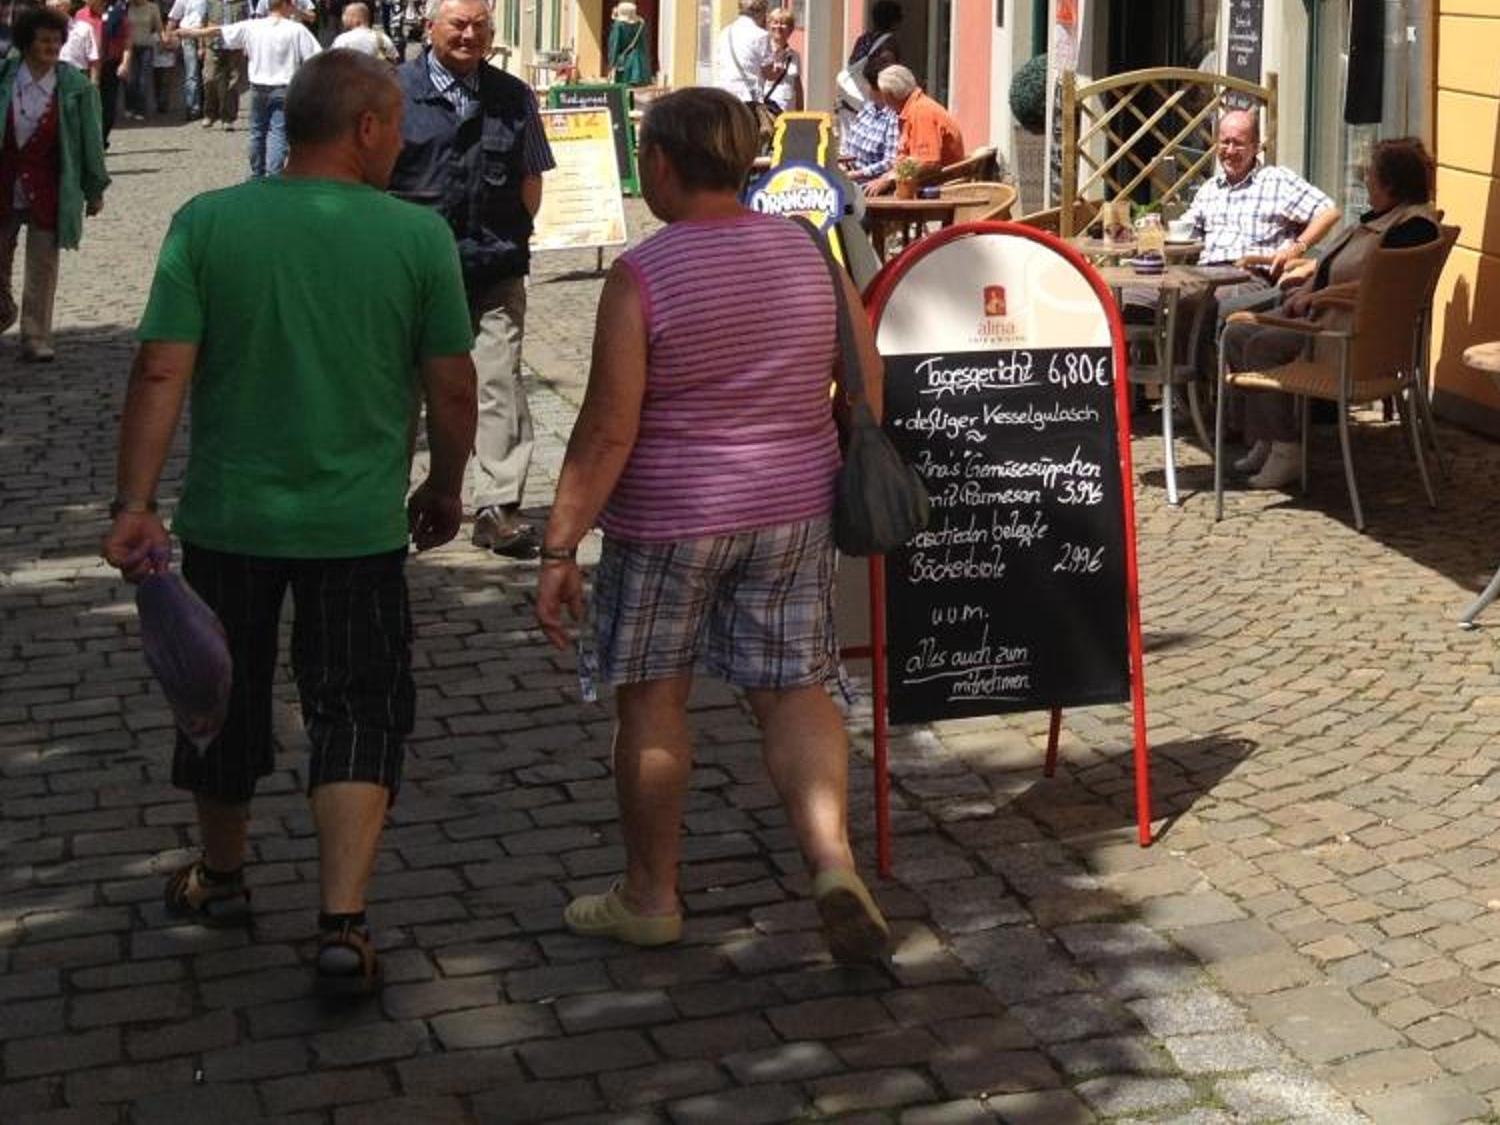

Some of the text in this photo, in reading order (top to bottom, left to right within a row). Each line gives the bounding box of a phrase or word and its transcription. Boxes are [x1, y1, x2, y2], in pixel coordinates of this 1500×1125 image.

[751, 187, 839, 217] ORANGINA
[915, 351, 1110, 398] Tagesgericht 6,80€
[905, 400, 1101, 440] deftiger Kesselgulasch
[963, 444, 1102, 490] Gemüsesüppchen
[959, 480, 1041, 506] Parmesan
[905, 636, 948, 673] alles
[951, 622, 991, 666] auch
